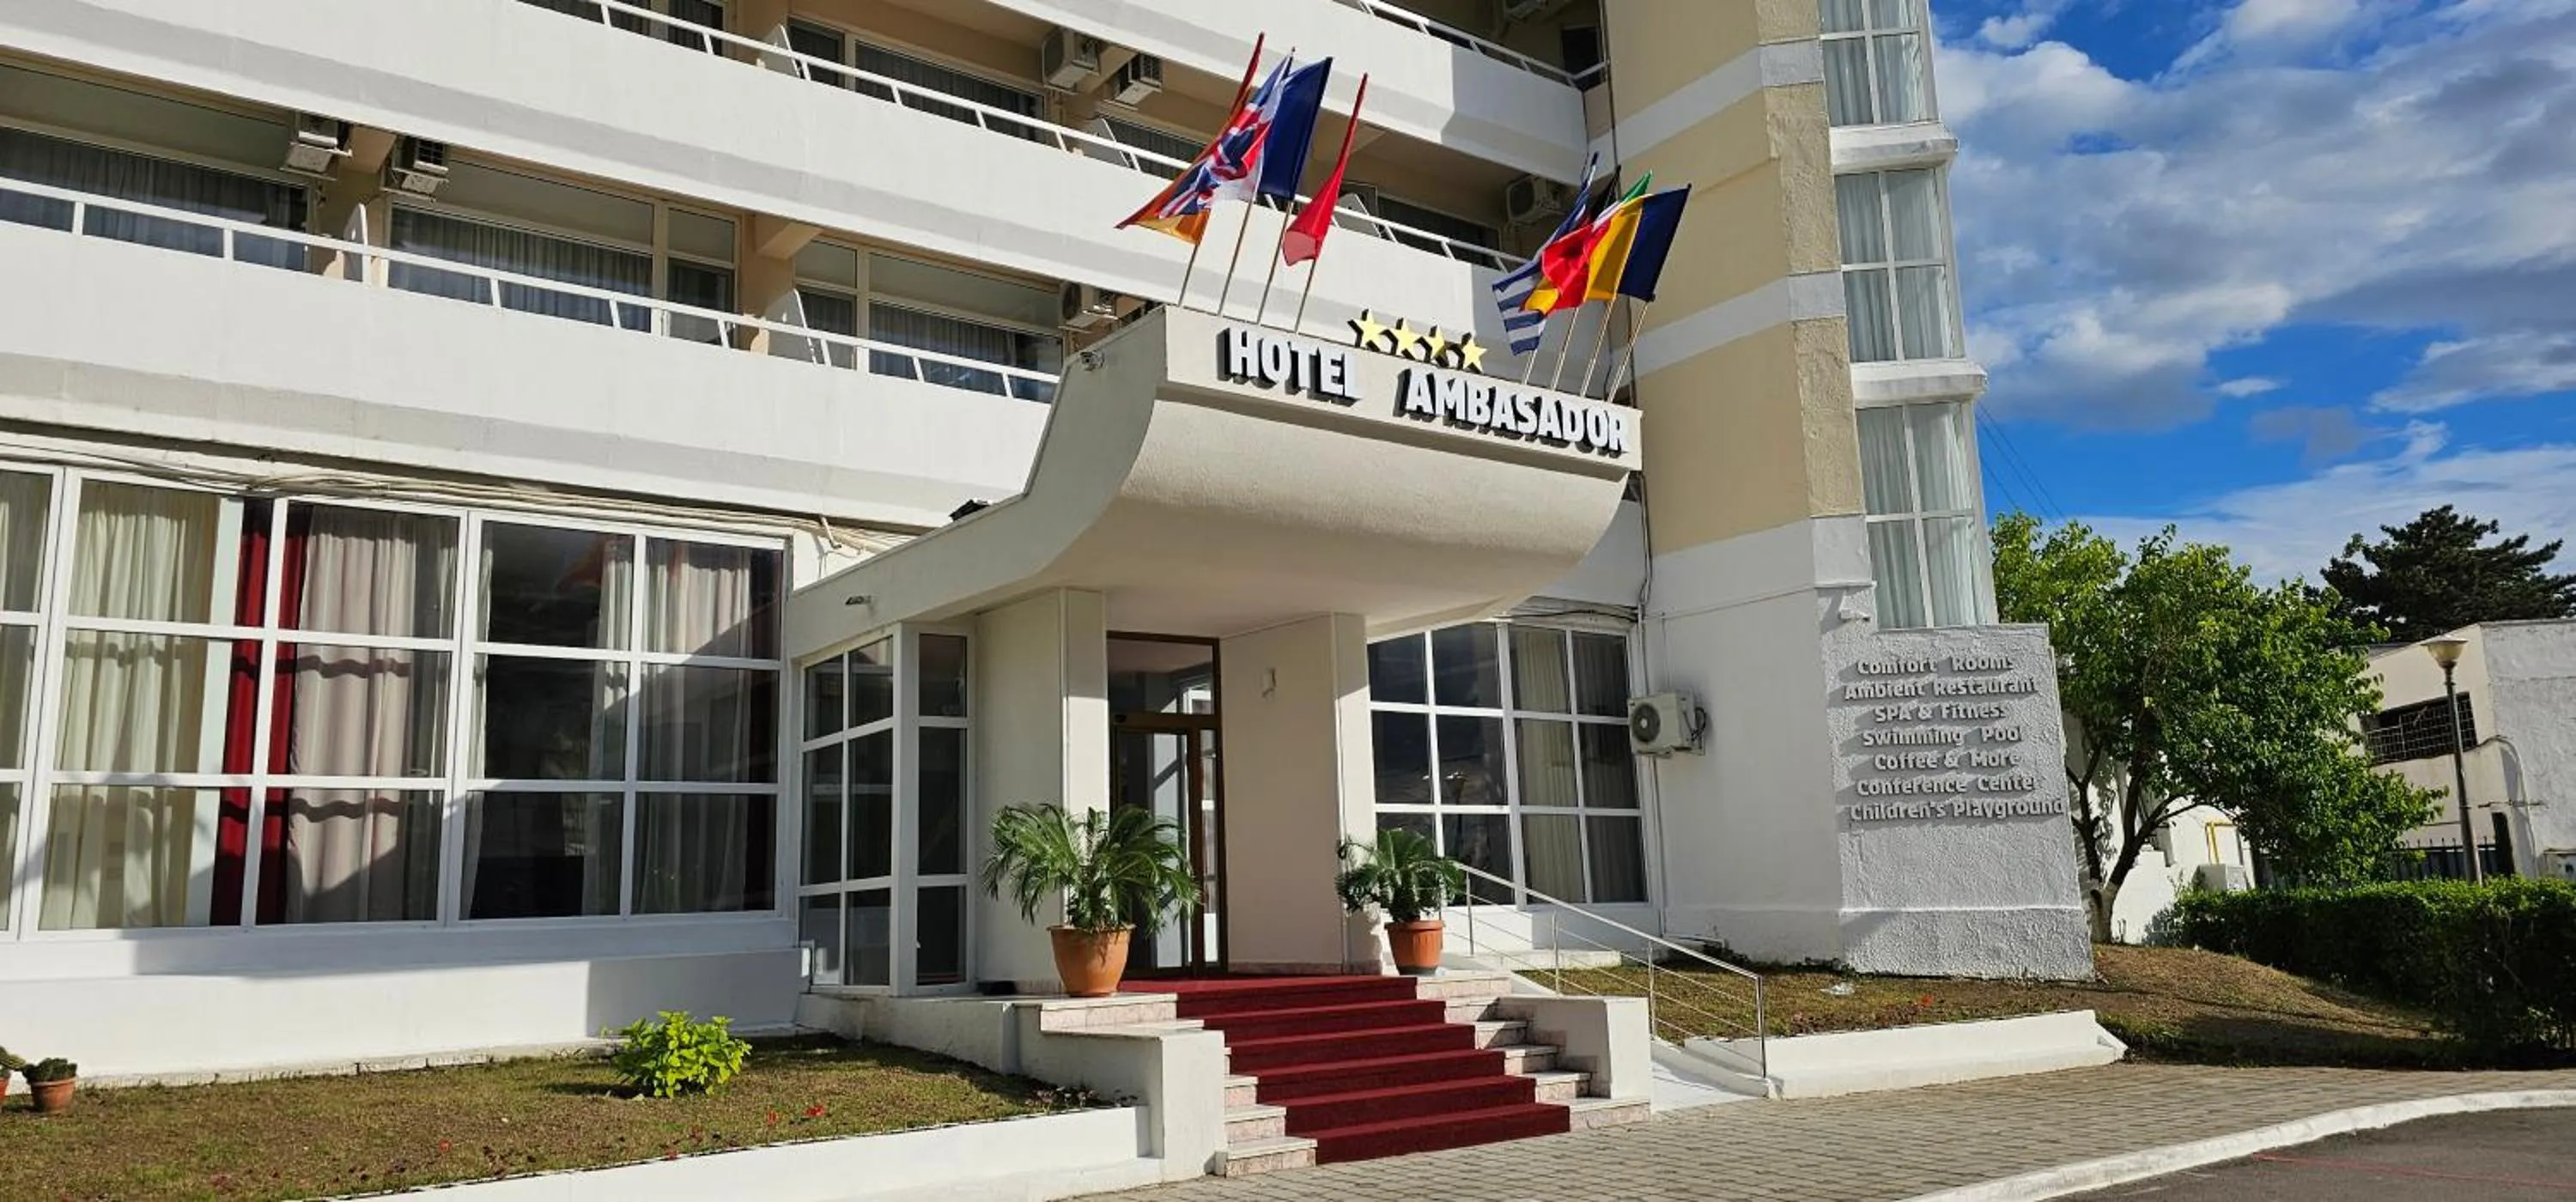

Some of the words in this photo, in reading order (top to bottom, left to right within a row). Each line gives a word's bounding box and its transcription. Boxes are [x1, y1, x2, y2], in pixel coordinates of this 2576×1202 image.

[1228, 325, 1363, 399] HOTEL
[1405, 368, 1628, 452] AMBASADOR
[1857, 659, 1937, 675] Comfort
[1950, 655, 2014, 671] Rooms
[1844, 680, 1925, 701] Ambient
[1934, 676, 2037, 695] Restaurant
[1874, 704, 1912, 722] SPA
[1918, 704, 1933, 720] &
[1941, 701, 2007, 719] Fitness
[1862, 728, 1964, 746] Swimming
[1874, 752, 1938, 770] Coffee
[1944, 750, 1959, 769] &
[1970, 750, 2021, 768] More
[1857, 776, 1967, 796] Conference
[1850, 800, 1947, 820] Children's
[1953, 797, 2064, 819] Playground
